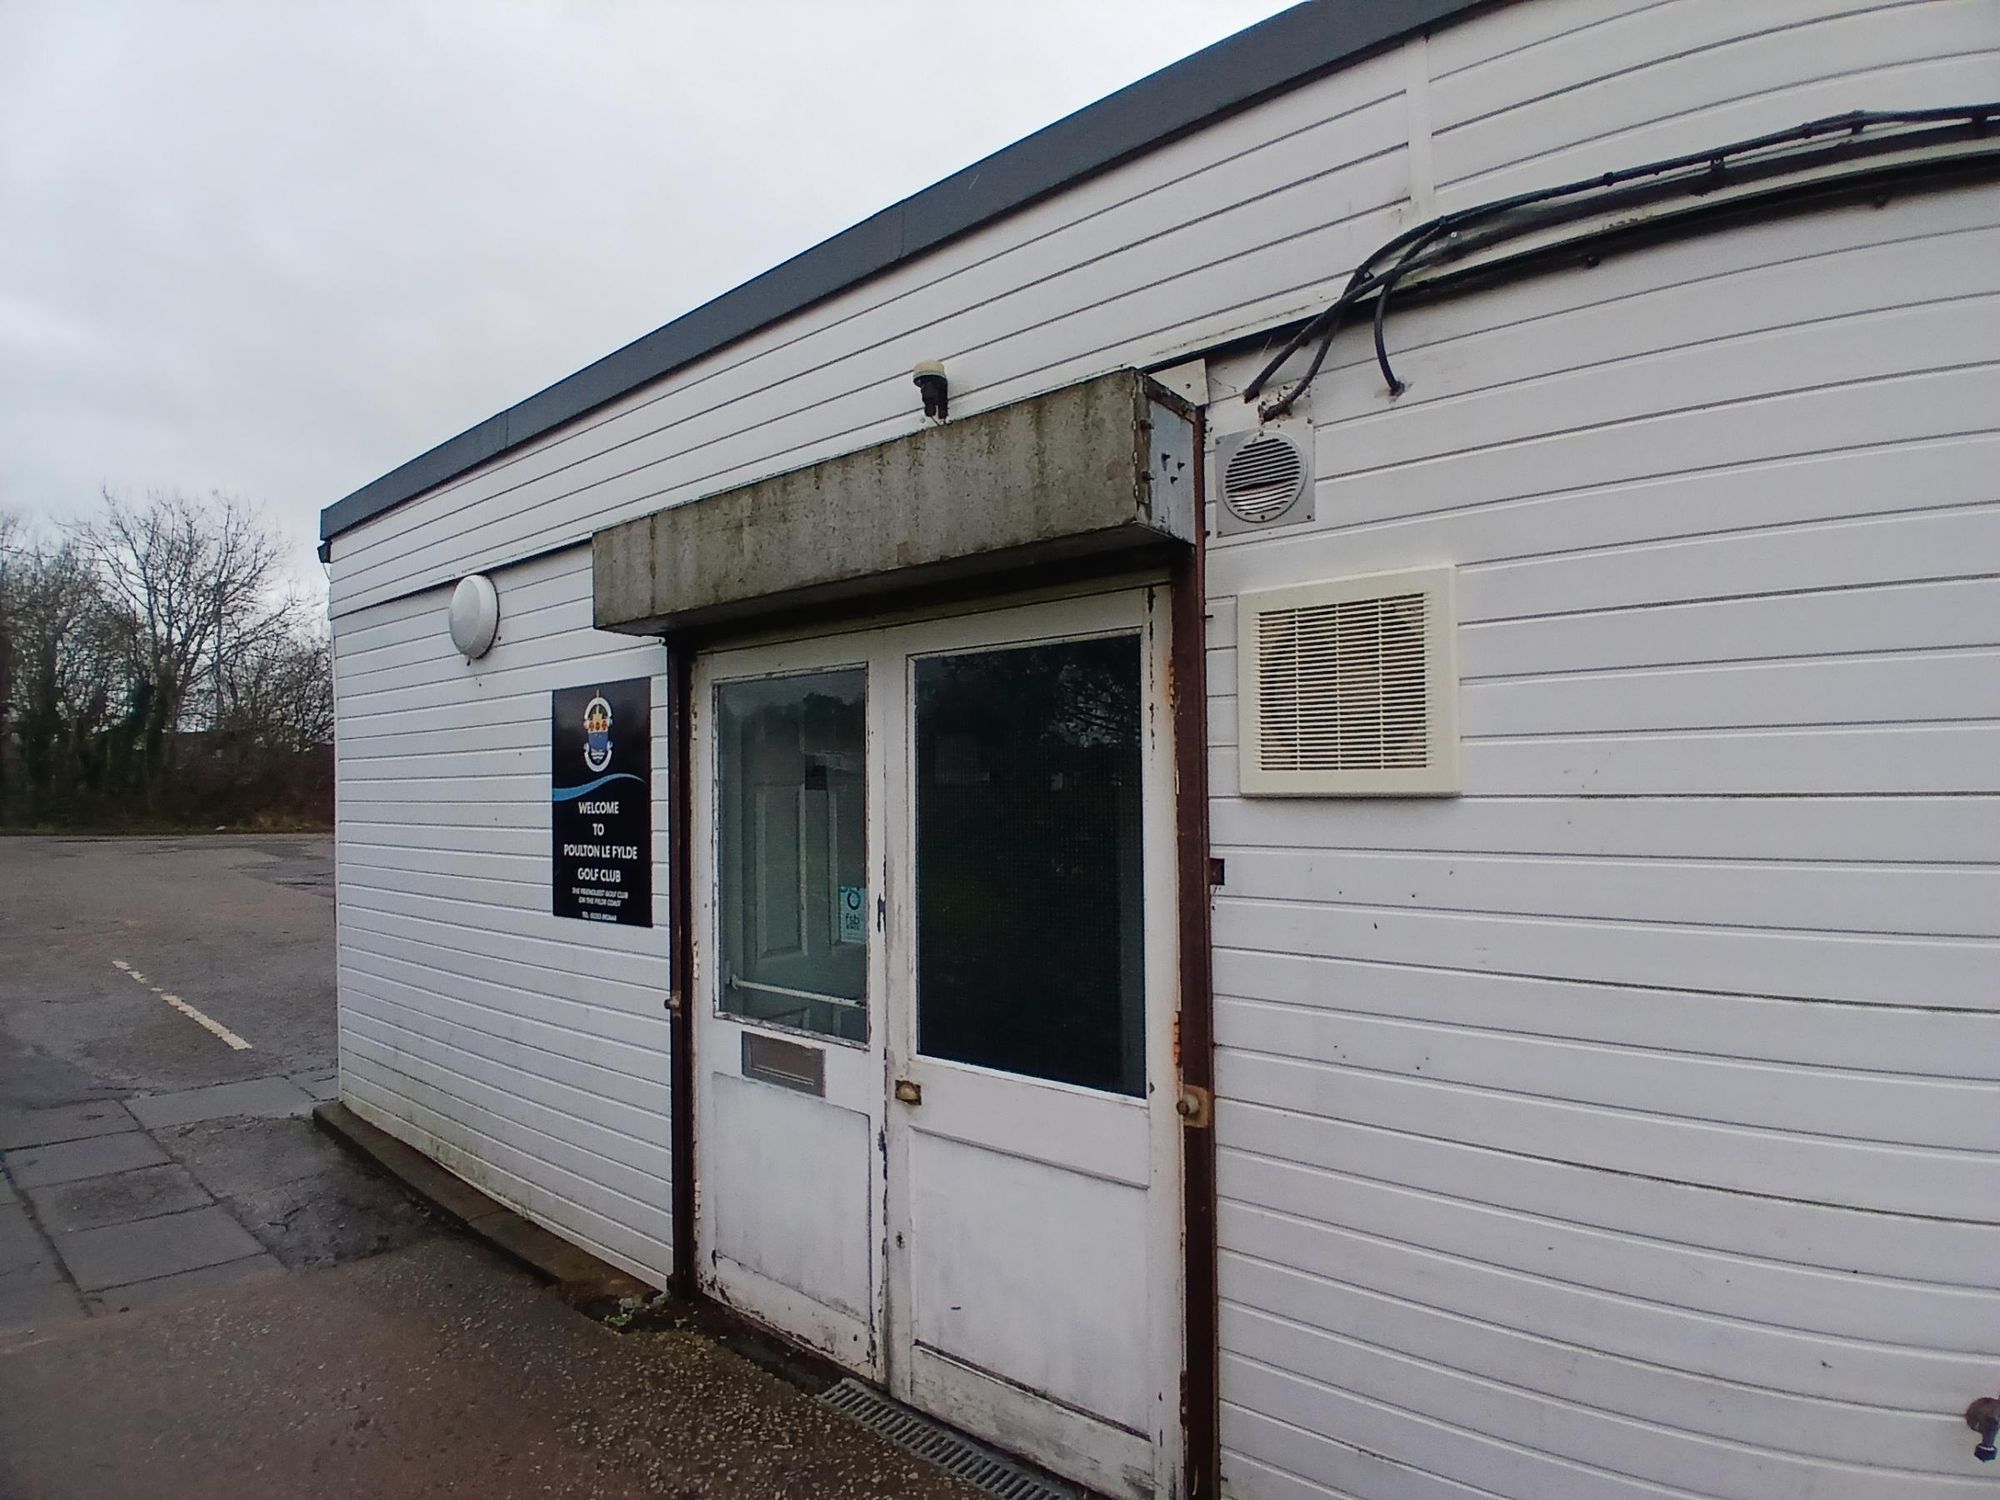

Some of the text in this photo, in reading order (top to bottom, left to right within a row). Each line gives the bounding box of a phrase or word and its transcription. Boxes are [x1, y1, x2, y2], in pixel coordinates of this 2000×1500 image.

[578, 801, 619, 814] WELCOME
[592, 823, 604, 836] TO
[563, 843, 638, 860] POULTON LE FYLDE
[577, 867, 621, 883] GOLF CLUB
